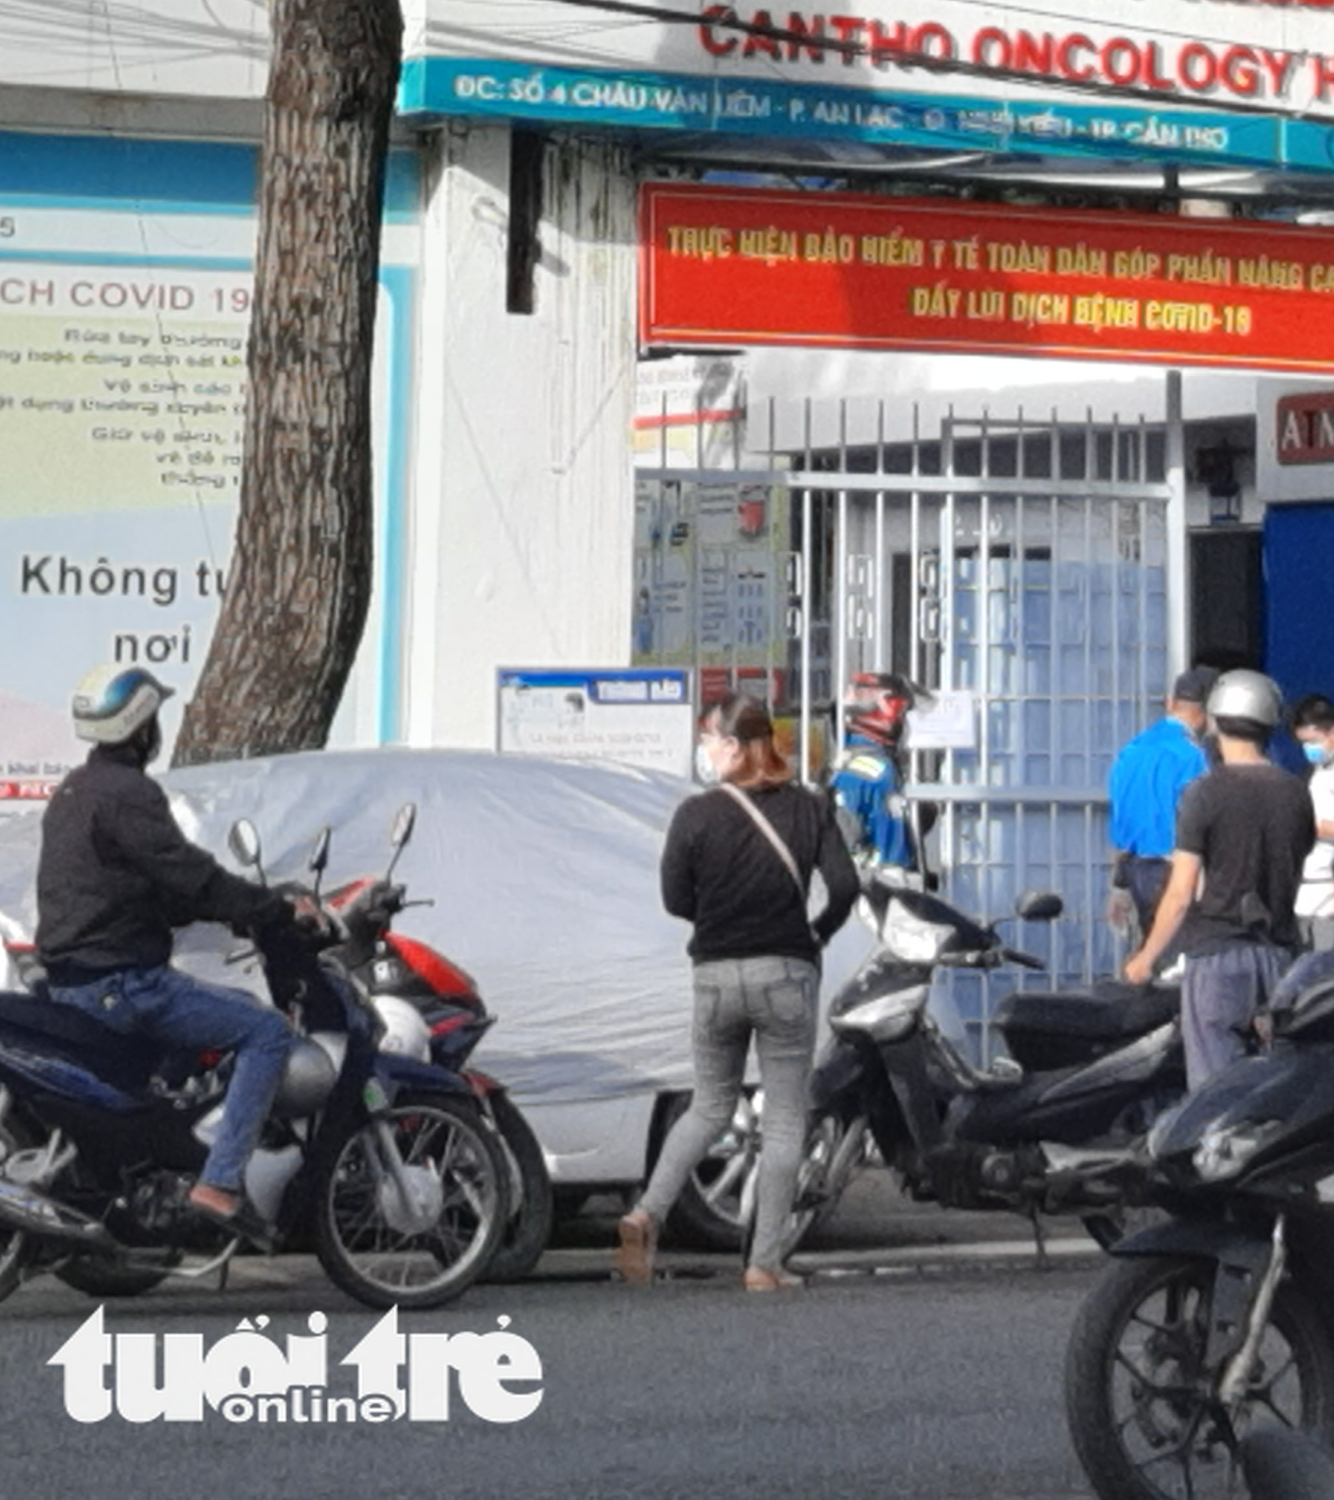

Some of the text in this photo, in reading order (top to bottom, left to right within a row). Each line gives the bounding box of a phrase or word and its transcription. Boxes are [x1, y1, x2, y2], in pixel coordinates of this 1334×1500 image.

[972, 27, 1291, 96] ONCOLOGY
[739, 225, 796, 266] HIỆN
[805, 226, 854, 262] BẢO
[862, 226, 924, 267] HIỂM
[929, 239, 946, 269] Y
[954, 232, 980, 272] TẾ
[988, 239, 1050, 274] TOÀN
[1056, 242, 1106, 277] DÂN
[1113, 246, 1158, 280] GÓP
[1237, 257, 1304, 292] NÂNG
[67, 278, 195, 312] COVID
[213, 285, 252, 313] 19
[1012, 290, 1068, 328] DỊCH
[1073, 293, 1138, 335] BỆNH
[1145, 300, 1253, 337] COVID-19
[20, 554, 179, 607] Không
[115, 624, 192, 663] nơi
